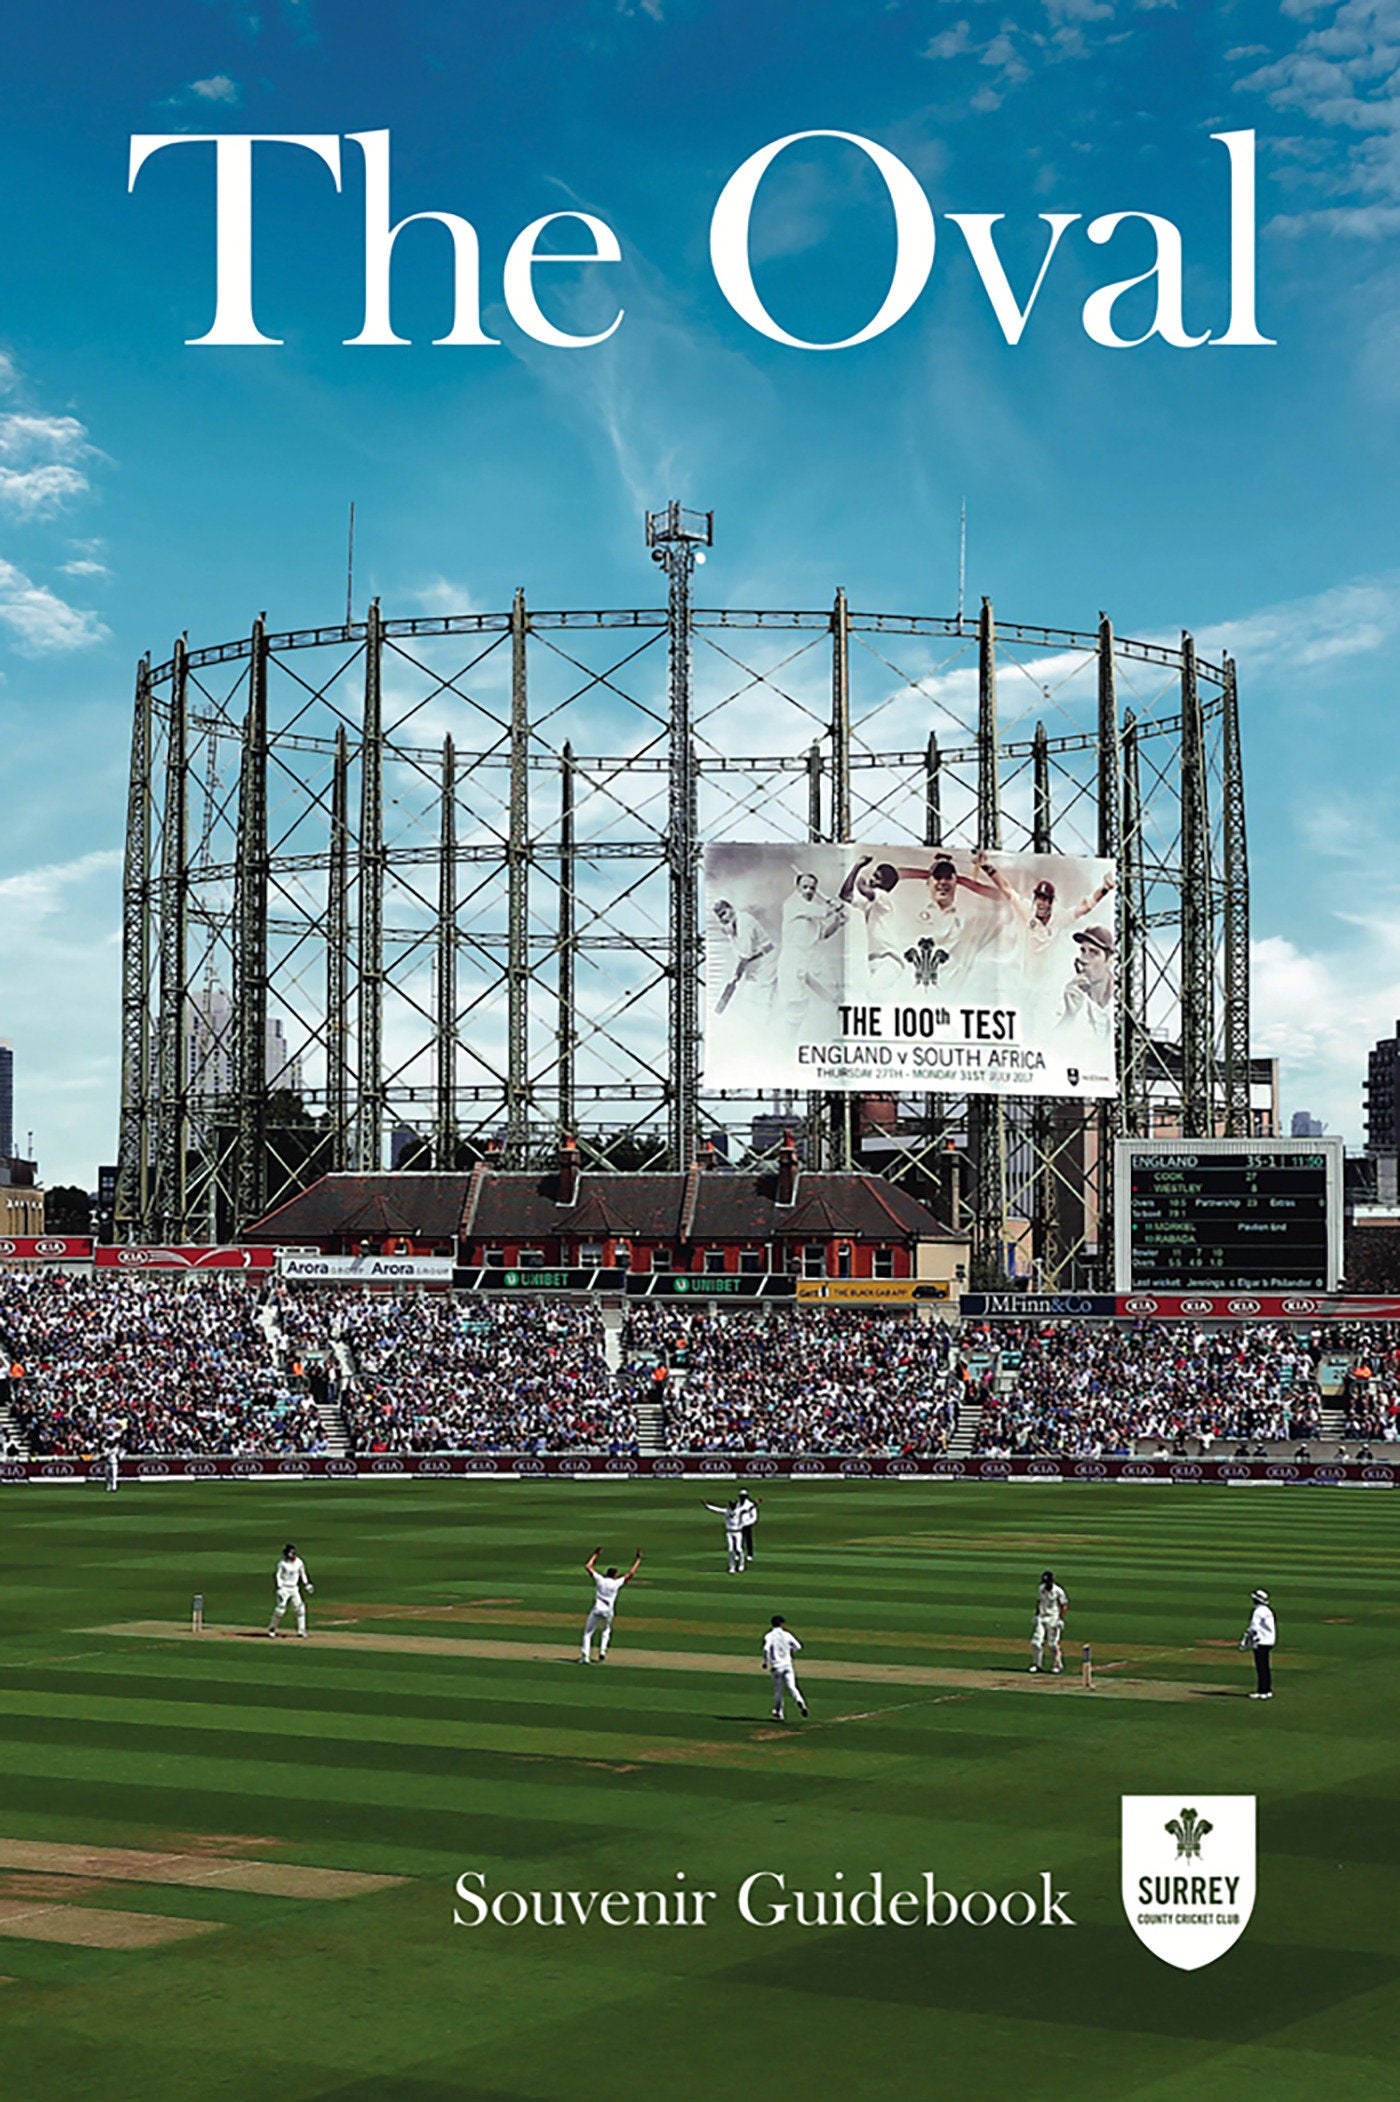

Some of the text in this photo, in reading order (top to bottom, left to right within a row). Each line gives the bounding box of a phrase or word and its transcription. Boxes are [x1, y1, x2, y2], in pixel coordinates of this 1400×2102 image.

[839, 1006, 1017, 1040] THE 100th TEST
[799, 1045, 892, 1065] ENGLAND
[913, 1047, 981, 1068] SOUTH
[988, 1049, 1046, 1070] AFRICA
[817, 1067, 873, 1079] THURSDAY
[912, 1069, 957, 1080] MONDAY
[1132, 1156, 1199, 1167] ENGLAND
[1153, 1172, 1184, 1181] COOK
[287, 1261, 329, 1275] Arora
[371, 1261, 414, 1275] Arora
[521, 1273, 568, 1286] UNIBET
[691, 1278, 741, 1291] UNIBET
